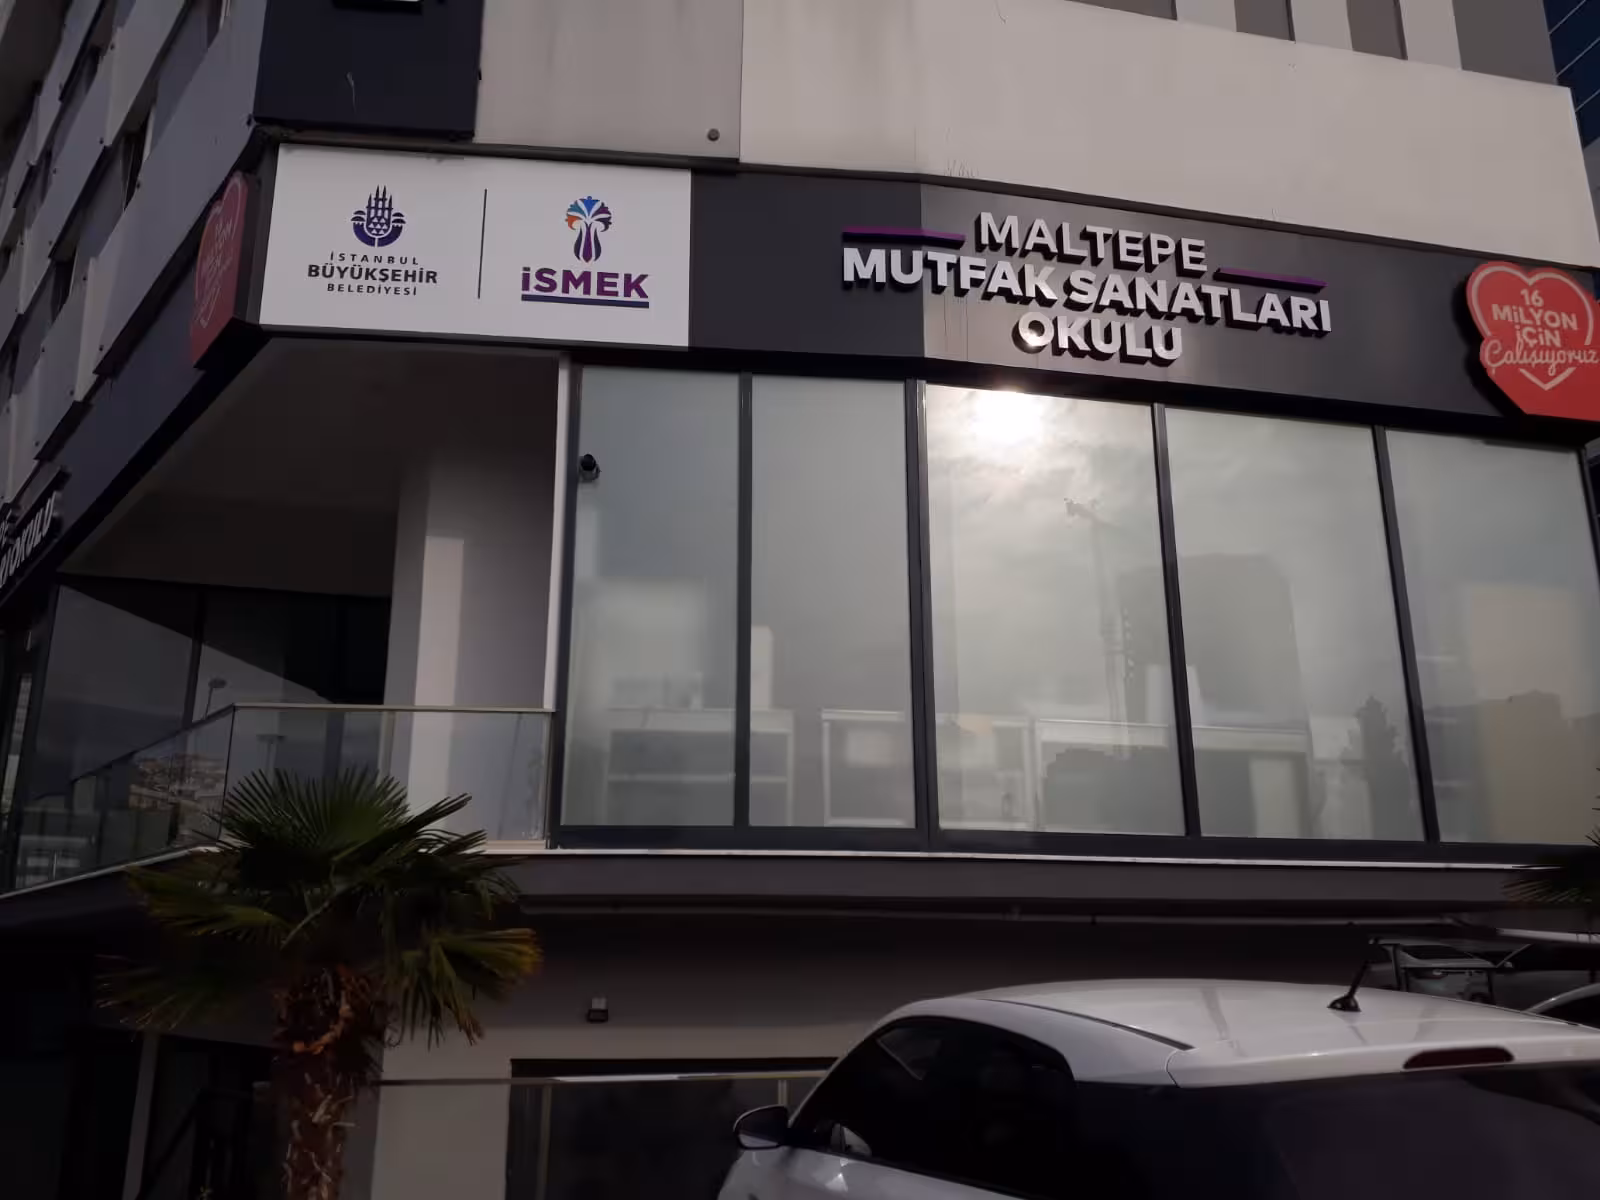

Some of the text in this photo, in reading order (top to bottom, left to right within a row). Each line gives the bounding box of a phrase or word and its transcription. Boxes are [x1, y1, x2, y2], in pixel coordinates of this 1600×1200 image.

[978, 211, 1208, 273] MALTEPE
[329, 250, 419, 266] İSTANBUL
[307, 262, 438, 284] BÜYÜKŞEHİR
[326, 283, 417, 296] BELEDİYESİ
[843, 247, 1332, 333] MUTFAK SANATLARI
[1520, 288, 1544, 307] 16
[1017, 311, 1184, 361] OKULU
